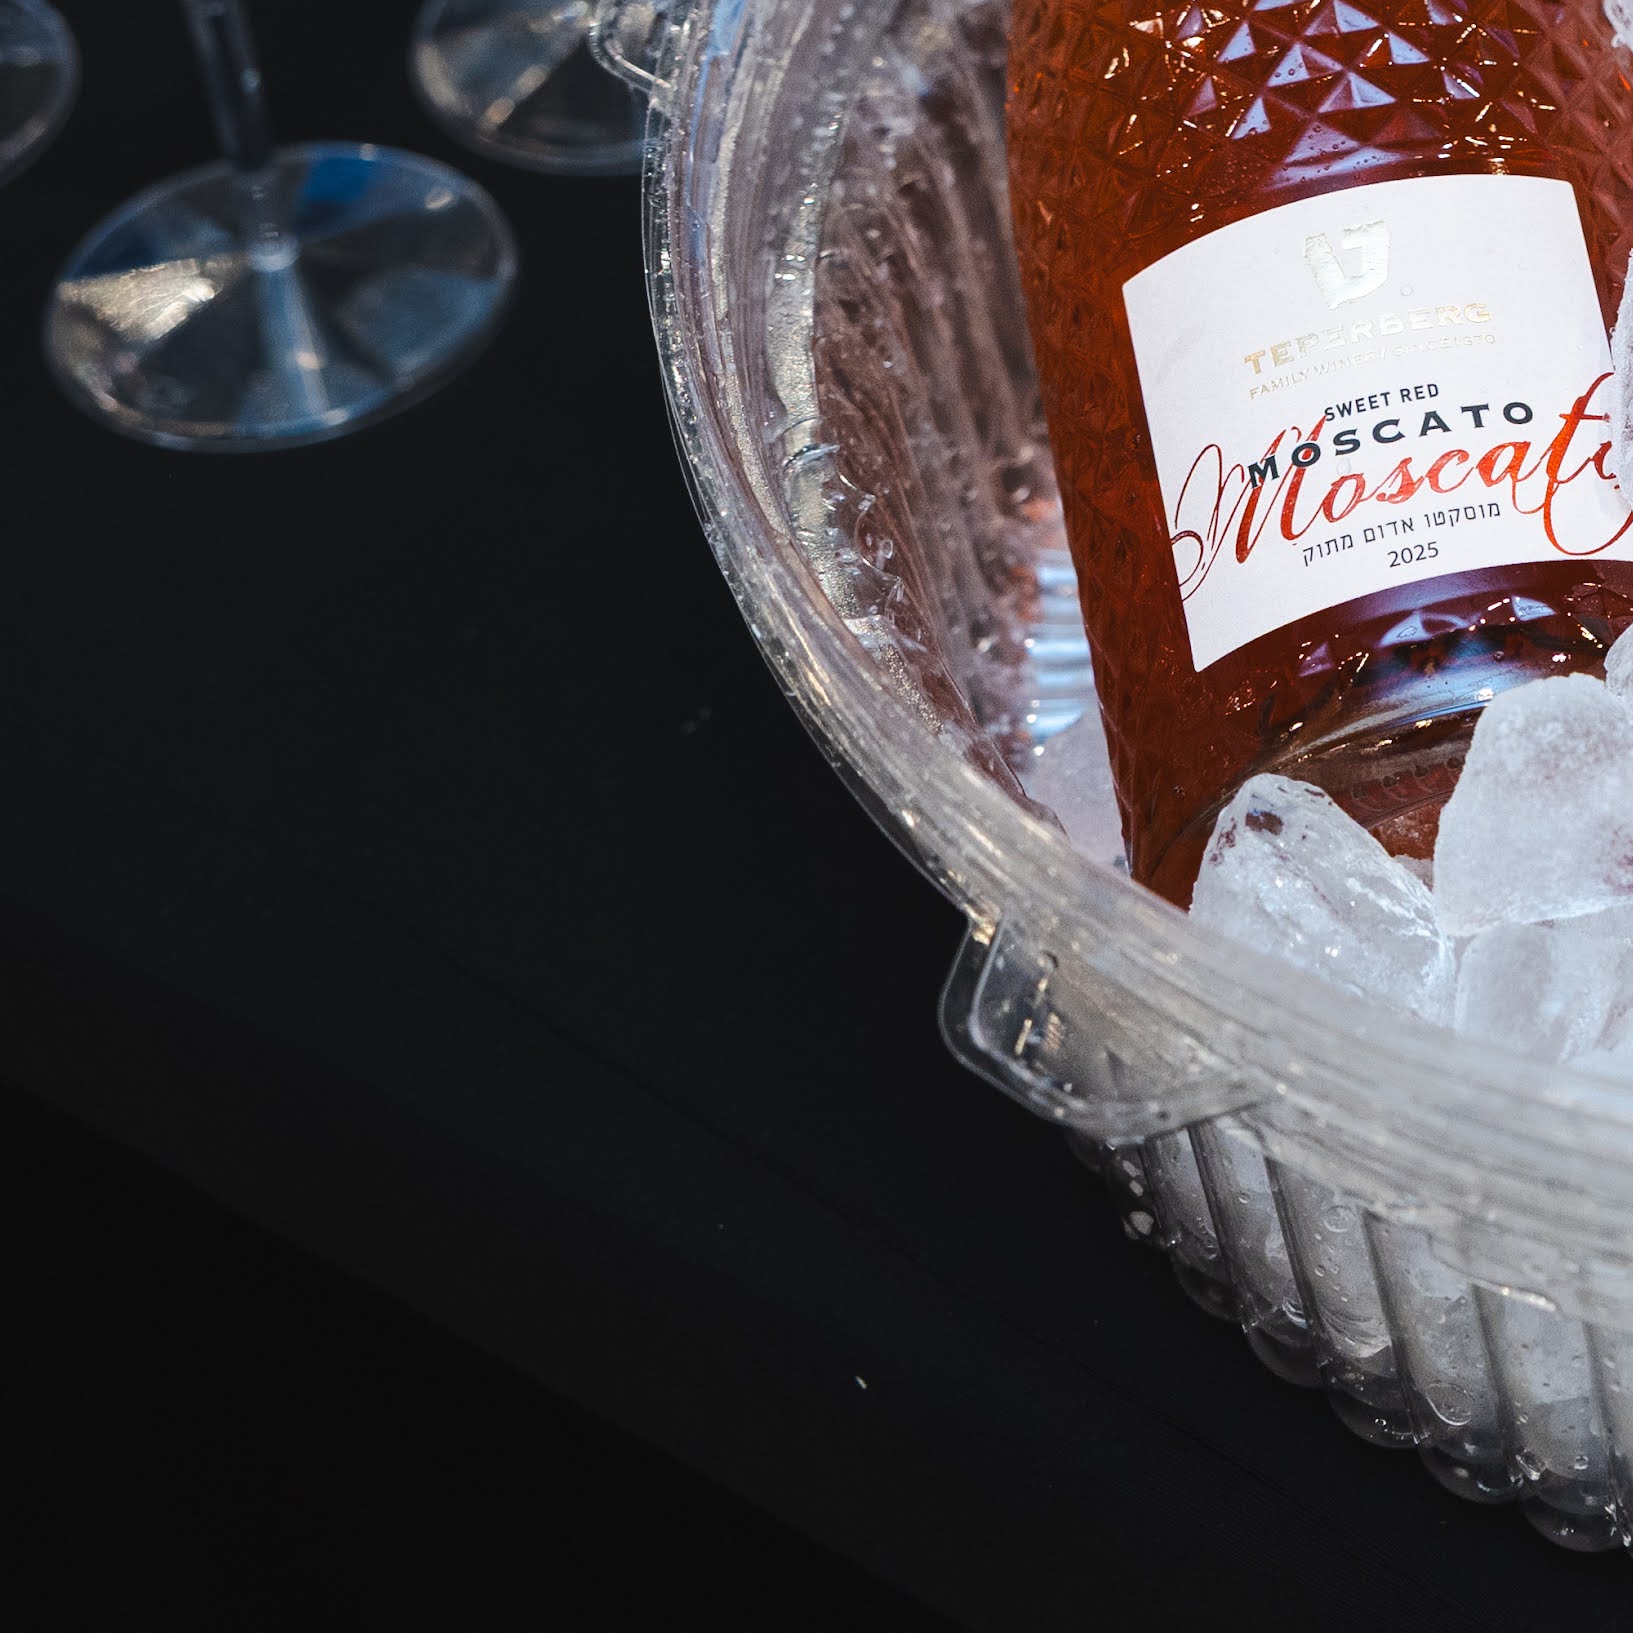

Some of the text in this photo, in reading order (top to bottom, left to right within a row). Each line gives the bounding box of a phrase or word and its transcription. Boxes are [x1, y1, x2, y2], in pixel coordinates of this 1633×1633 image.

[1243, 302, 1493, 376] TEPERBERG
[1250, 368, 1309, 400] FAMILY
[1324, 383, 1439, 422] SWEET RED
[1248, 401, 1533, 489] MOSCATO
[1302, 501, 1501, 567] מוסקטו אדום מתוק
[1387, 541, 1439, 568] 2025
